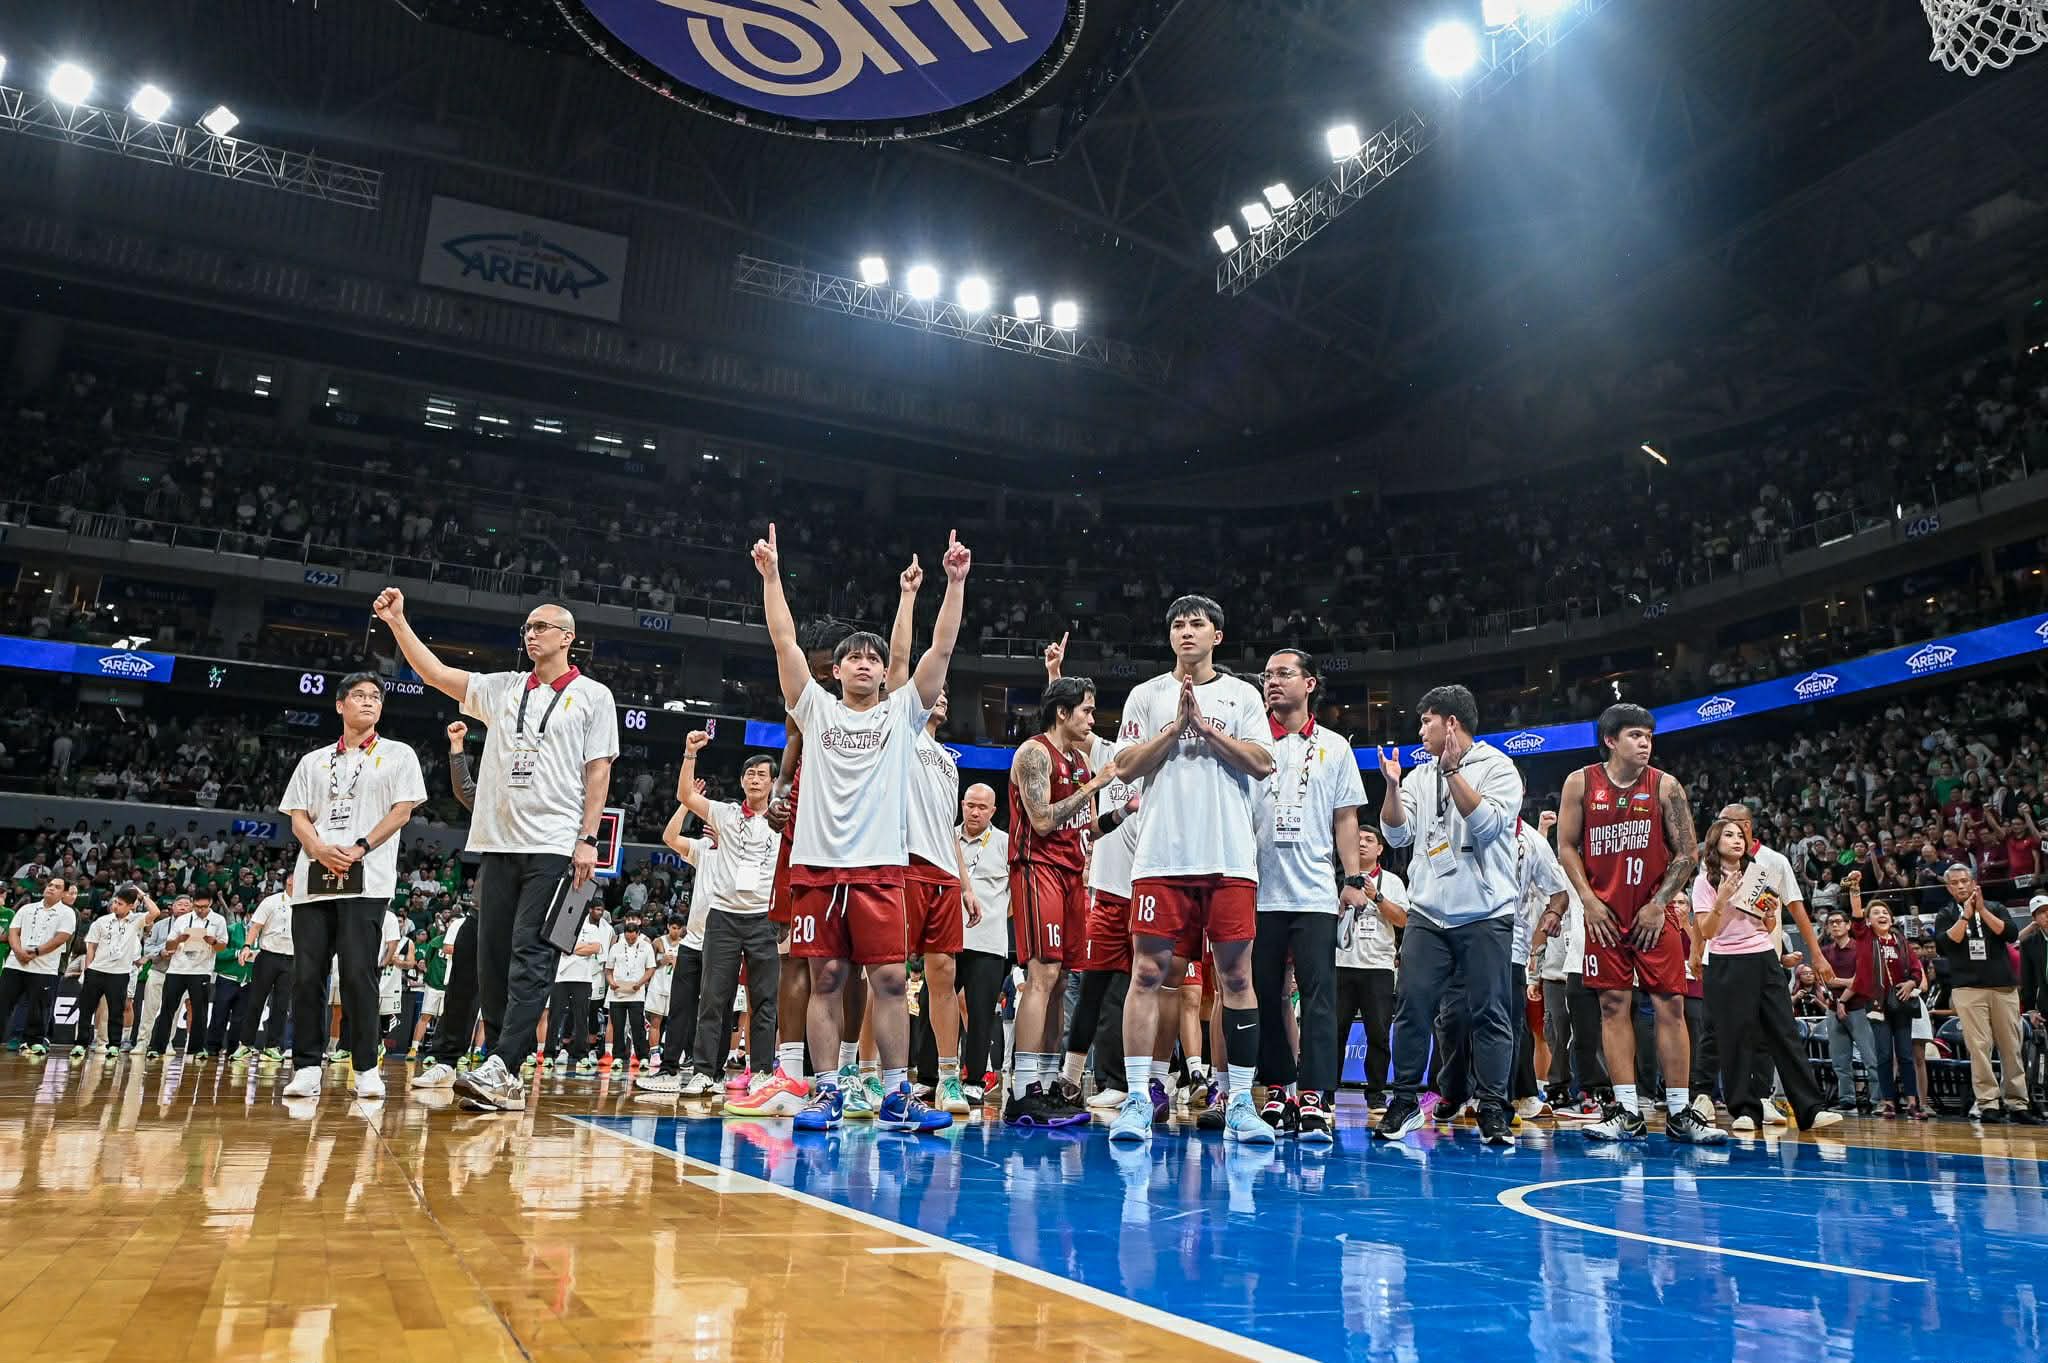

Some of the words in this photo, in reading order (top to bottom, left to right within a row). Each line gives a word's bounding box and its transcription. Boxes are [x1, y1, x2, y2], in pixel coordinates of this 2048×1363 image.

[462, 251, 580, 299] ARENA
[1907, 516, 1940, 537] 405
[305, 570, 339, 586] 422
[642, 615, 670, 632] 401
[103, 659, 148, 673] ARENA
[1912, 651, 1953, 670] ARENA
[299, 672, 325, 695] 63
[396, 682, 424, 696] CLOCK
[1799, 679, 1835, 696] ARENA
[625, 709, 647, 730] 66
[1700, 702, 1733, 718] ARENA
[820, 726, 882, 750] STATE
[1508, 738, 1542, 750] ARENA
[1596, 803, 1609, 811] BPI
[239, 819, 272, 839] 122
[1590, 819, 1652, 842] UNIBERSIDAD
[1590, 840, 1602, 857] NG
[1604, 833, 1649, 855] PILIPINAS
[1625, 856, 1644, 886] 19
[1137, 894, 1156, 922] 18
[792, 914, 815, 943] 20
[1046, 923, 1061, 948] 16
[1585, 954, 1599, 977] 19
